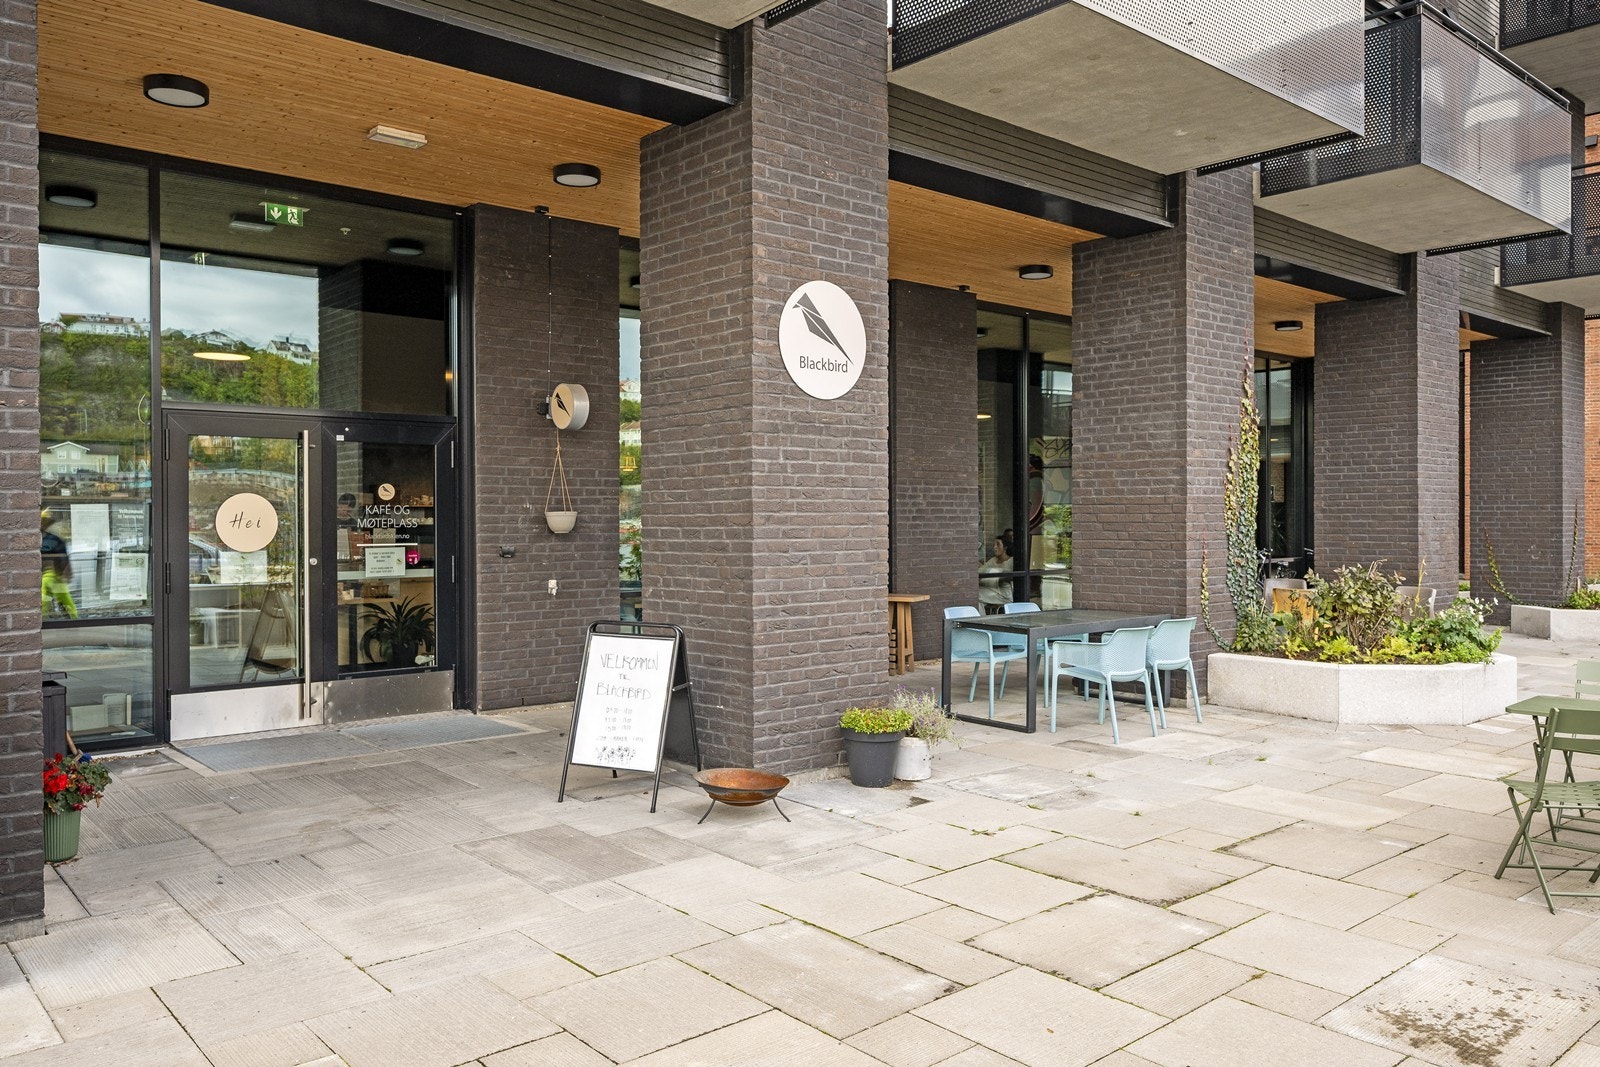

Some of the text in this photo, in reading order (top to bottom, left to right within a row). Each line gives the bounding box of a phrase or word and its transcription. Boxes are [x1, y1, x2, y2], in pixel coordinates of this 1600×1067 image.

[799, 355, 848, 373] Blackbird
[365, 503, 410, 515] KAFÉ OG
[229, 511, 262, 529] Hei
[357, 517, 418, 529] MØTEPLASS
[600, 651, 659, 671] VELKOMMEN
[596, 682, 652, 700] BLACKBIRD
